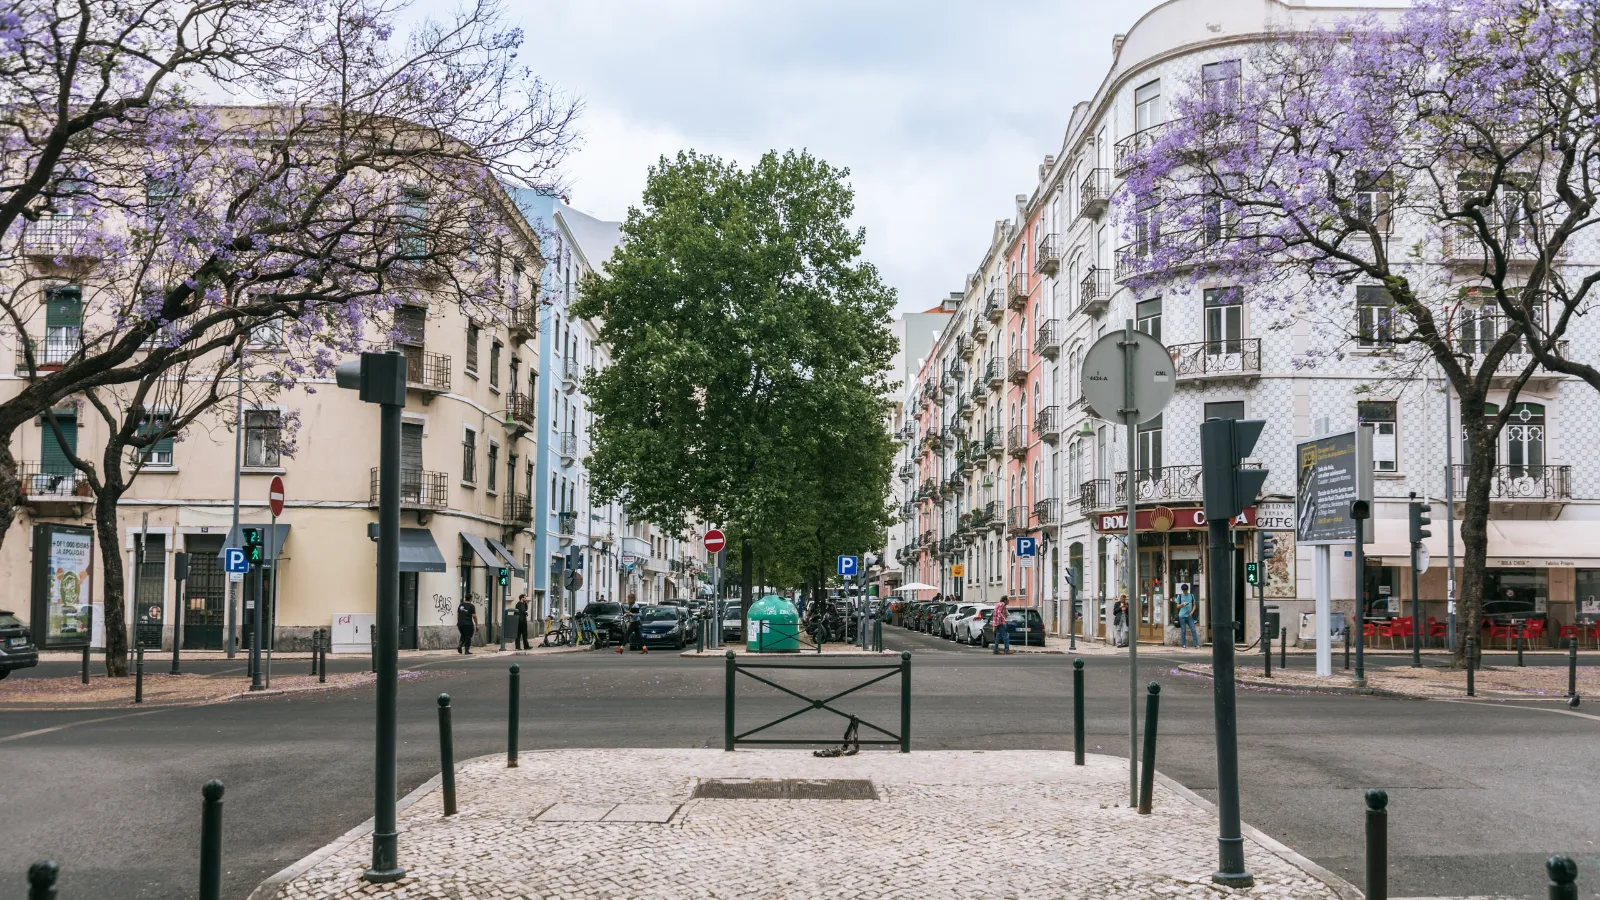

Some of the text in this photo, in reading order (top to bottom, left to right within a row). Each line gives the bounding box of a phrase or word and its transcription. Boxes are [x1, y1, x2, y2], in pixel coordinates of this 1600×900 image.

[1102, 515, 1129, 530] BOL
[1020, 539, 1031, 554] P
[230, 551, 244, 570] P
[841, 557, 854, 574] P
